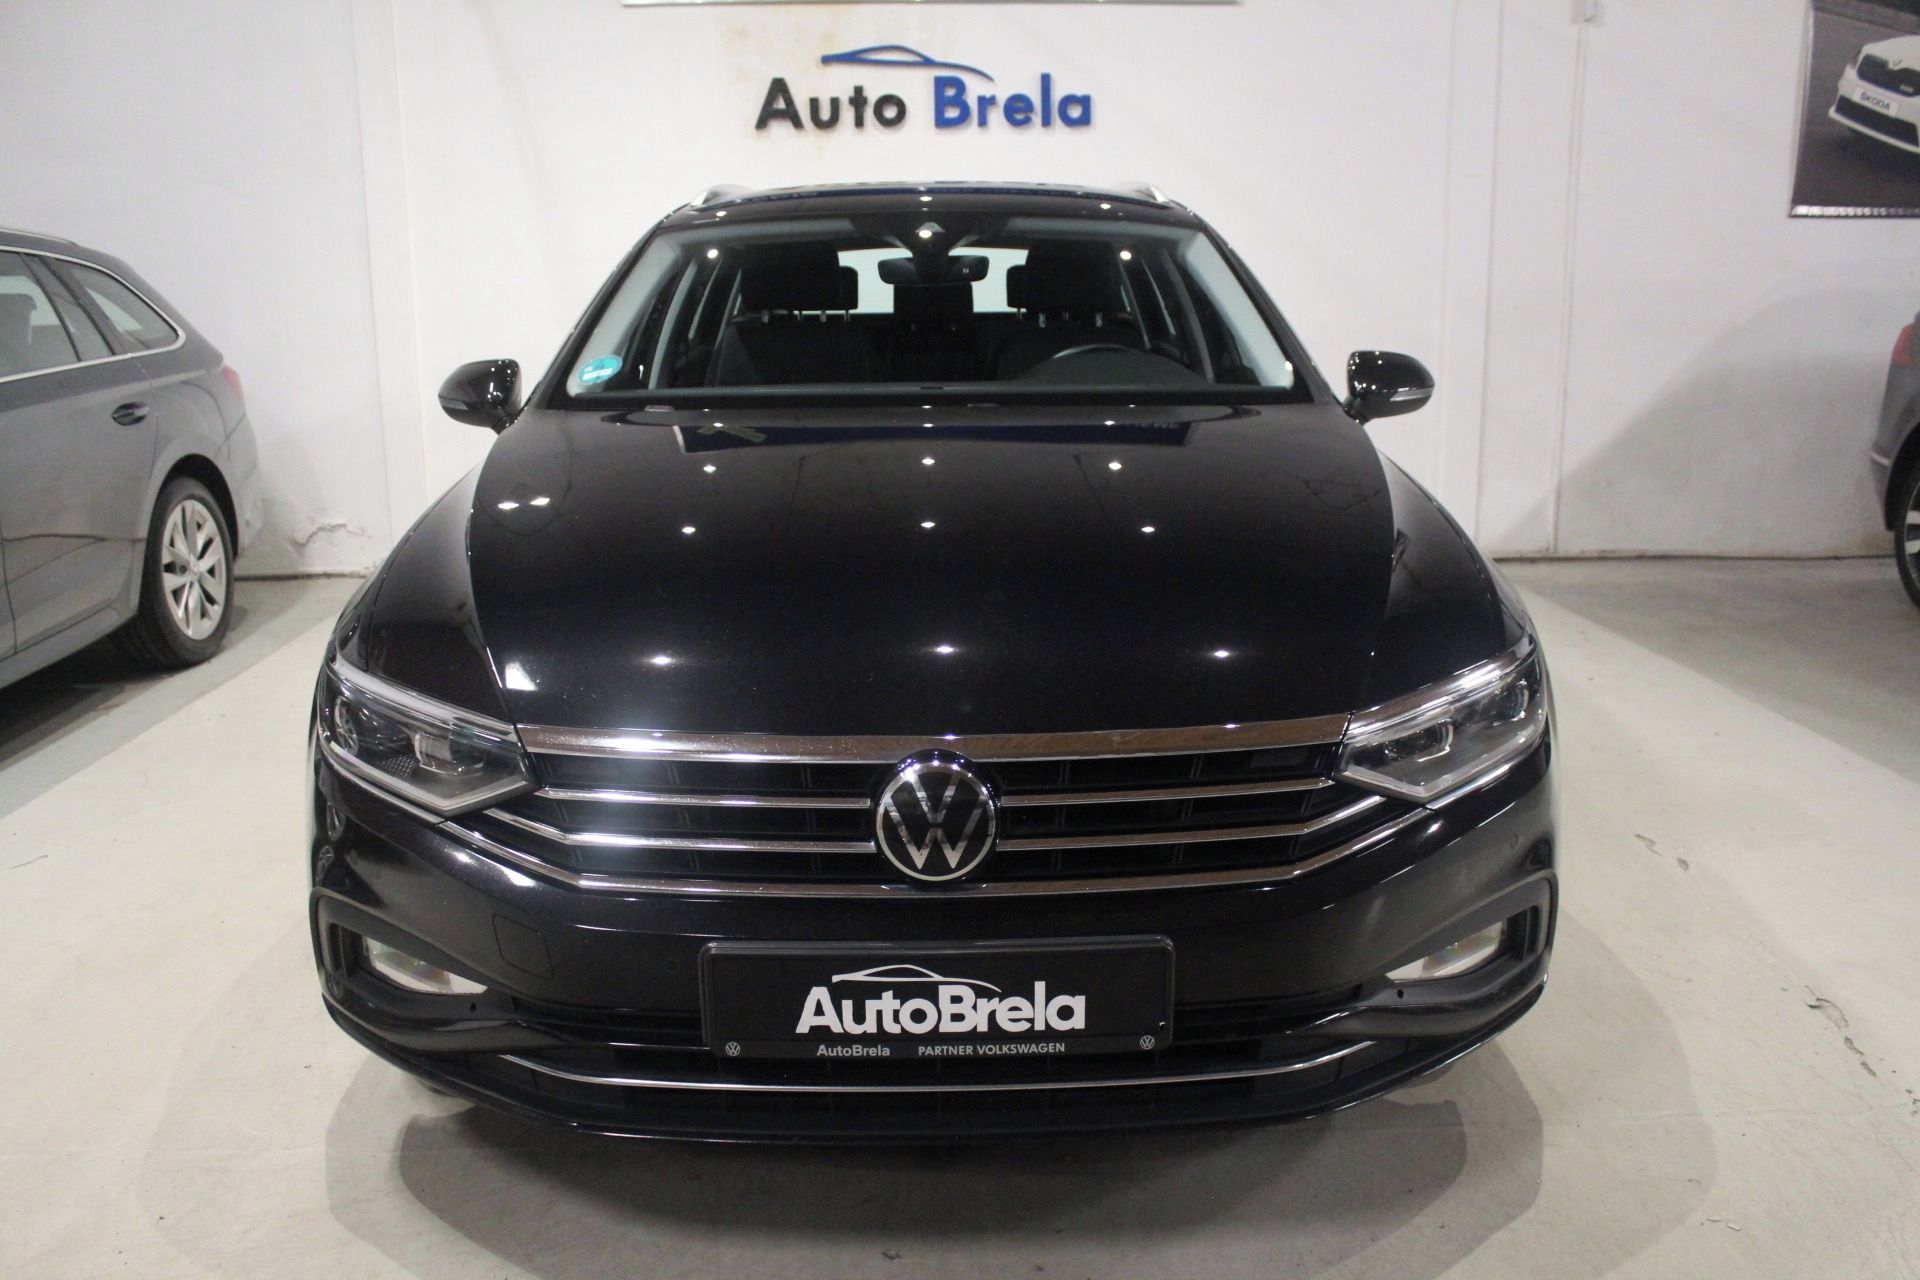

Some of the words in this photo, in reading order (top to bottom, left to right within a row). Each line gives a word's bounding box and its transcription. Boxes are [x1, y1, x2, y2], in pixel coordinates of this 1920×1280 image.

[755, 77, 907, 131] Auto
[933, 72, 1092, 129] Brela
[795, 980, 1086, 1035] AutoBrela
[816, 1044, 891, 1057] AutoBrela
[917, 1045, 974, 1056] PARTNER
[976, 1042, 1066, 1055] VOLKSWAGEN
